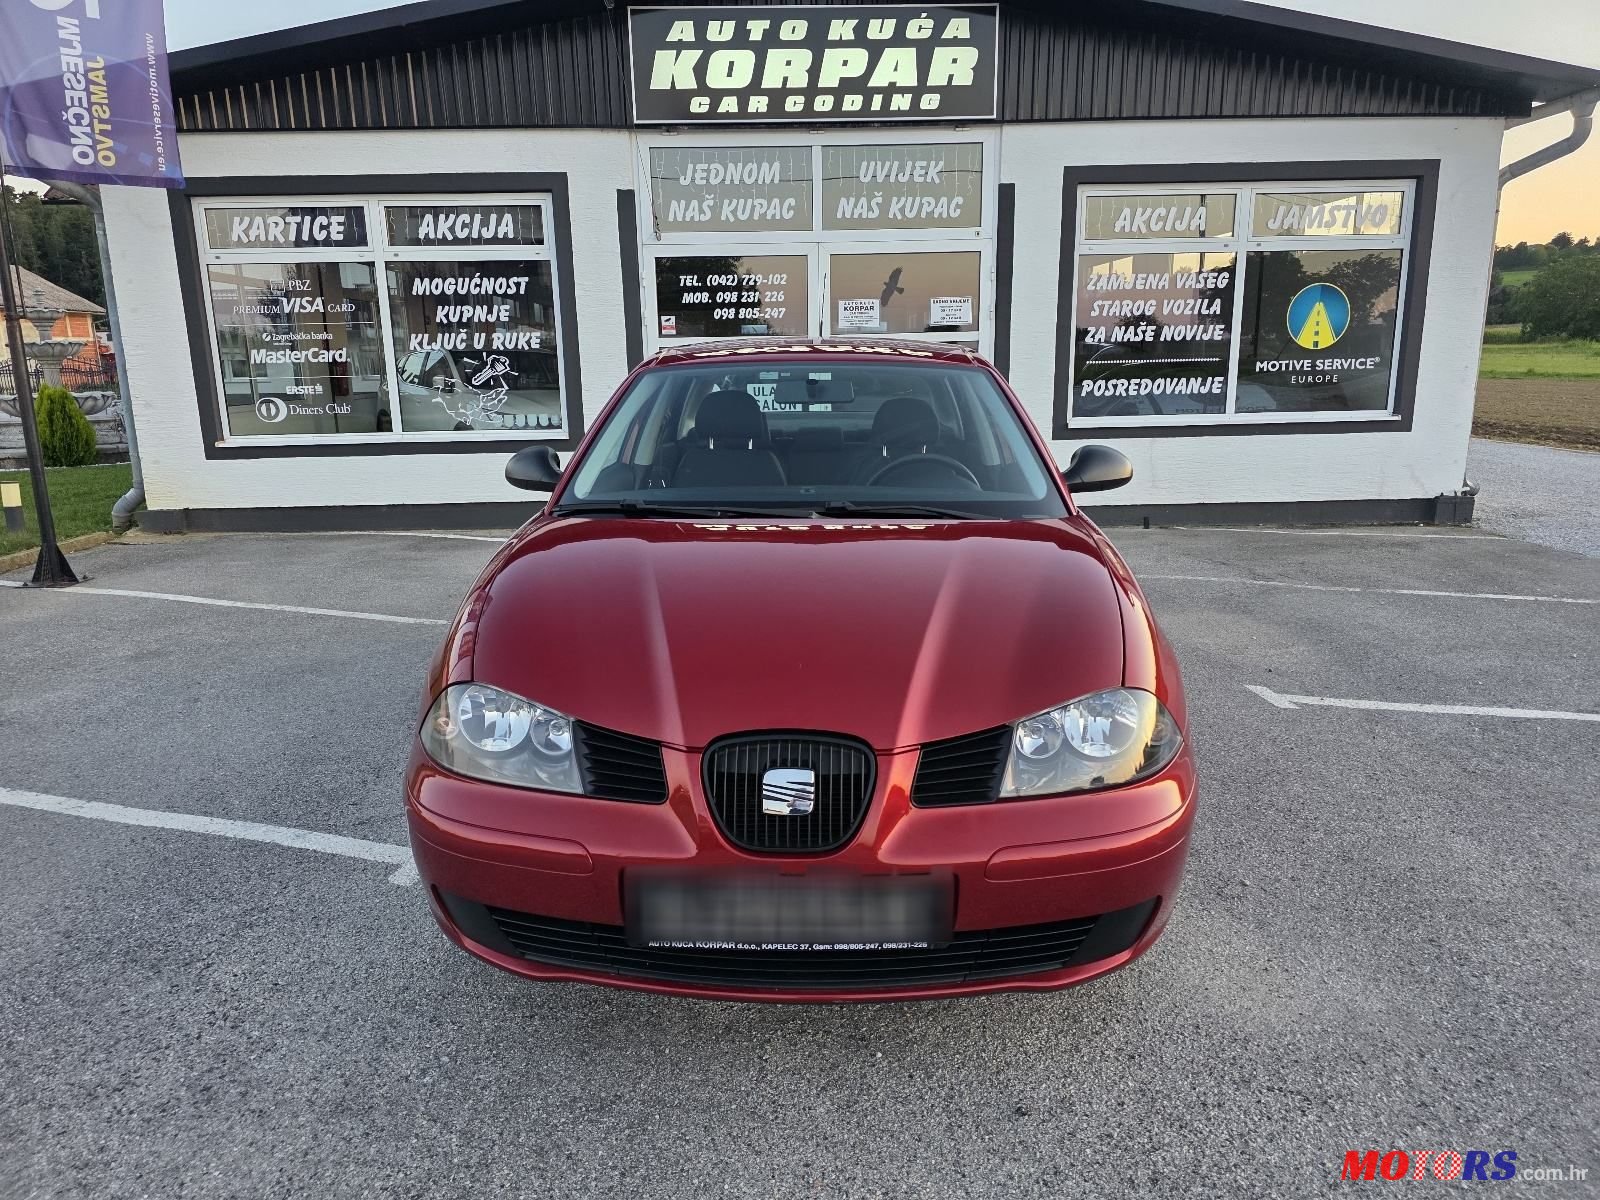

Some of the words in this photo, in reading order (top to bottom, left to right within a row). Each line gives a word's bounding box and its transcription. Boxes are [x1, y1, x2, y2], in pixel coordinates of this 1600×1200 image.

[666, 20, 808, 41] AUTO
[828, 13, 970, 40] KUĆA
[650, 47, 978, 90] KORPAR
[690, 96, 769, 113] CAR
[785, 94, 940, 112] CODING
[679, 162, 780, 185] JEDNOM
[859, 160, 944, 183] UVIJEK
[669, 194, 714, 221] NAŠ
[721, 197, 796, 222] KUPAC
[836, 192, 882, 219] NAŠ
[888, 196, 963, 219] KUPAC
[1114, 207, 1207, 233] AKCIJA
[1268, 204, 1388, 229] JAMSTVO
[232, 216, 345, 243] KARTICE
[418, 214, 514, 240] AKCIJA
[288, 280, 311, 290] PBZ
[412, 273, 528, 295] MOGUĆNOST
[680, 275, 701, 286] TEL.
[707, 275, 737, 286] (042)
[742, 274, 788, 286] 729-102
[1087, 273, 1169, 292] ZAMJENA
[1176, 270, 1230, 290] VAŠEG
[233, 306, 280, 314] PREMIUM
[280, 297, 324, 313] VISA
[328, 304, 355, 312] CARD
[682, 292, 712, 304] MOB.
[716, 292, 737, 303] 098
[741, 292, 760, 302] 231
[765, 291, 785, 302] 226
[436, 305, 510, 324] KUPNJE
[714, 308, 735, 320] 098
[739, 308, 786, 319] 805-247
[1091, 300, 1156, 317] STAROG
[1162, 299, 1221, 315] VOZILA
[410, 329, 468, 350] KLJUČ
[474, 333, 486, 349] U
[492, 332, 541, 350] RUKE
[1085, 327, 1105, 342] ZA
[1111, 322, 1156, 342] NAŠE
[1160, 325, 1224, 341] NOVIJE
[1256, 360, 1311, 372] MOTIVE
[1081, 377, 1224, 397] POSREDOVANJE
[1292, 375, 1338, 383] EUROPE
[286, 386, 315, 394] ERSTE
[753, 386, 776, 396] ULA
[289, 404, 323, 414] Diners
[757, 400, 797, 410] ALON
[696, 941, 735, 949] KORPAR
